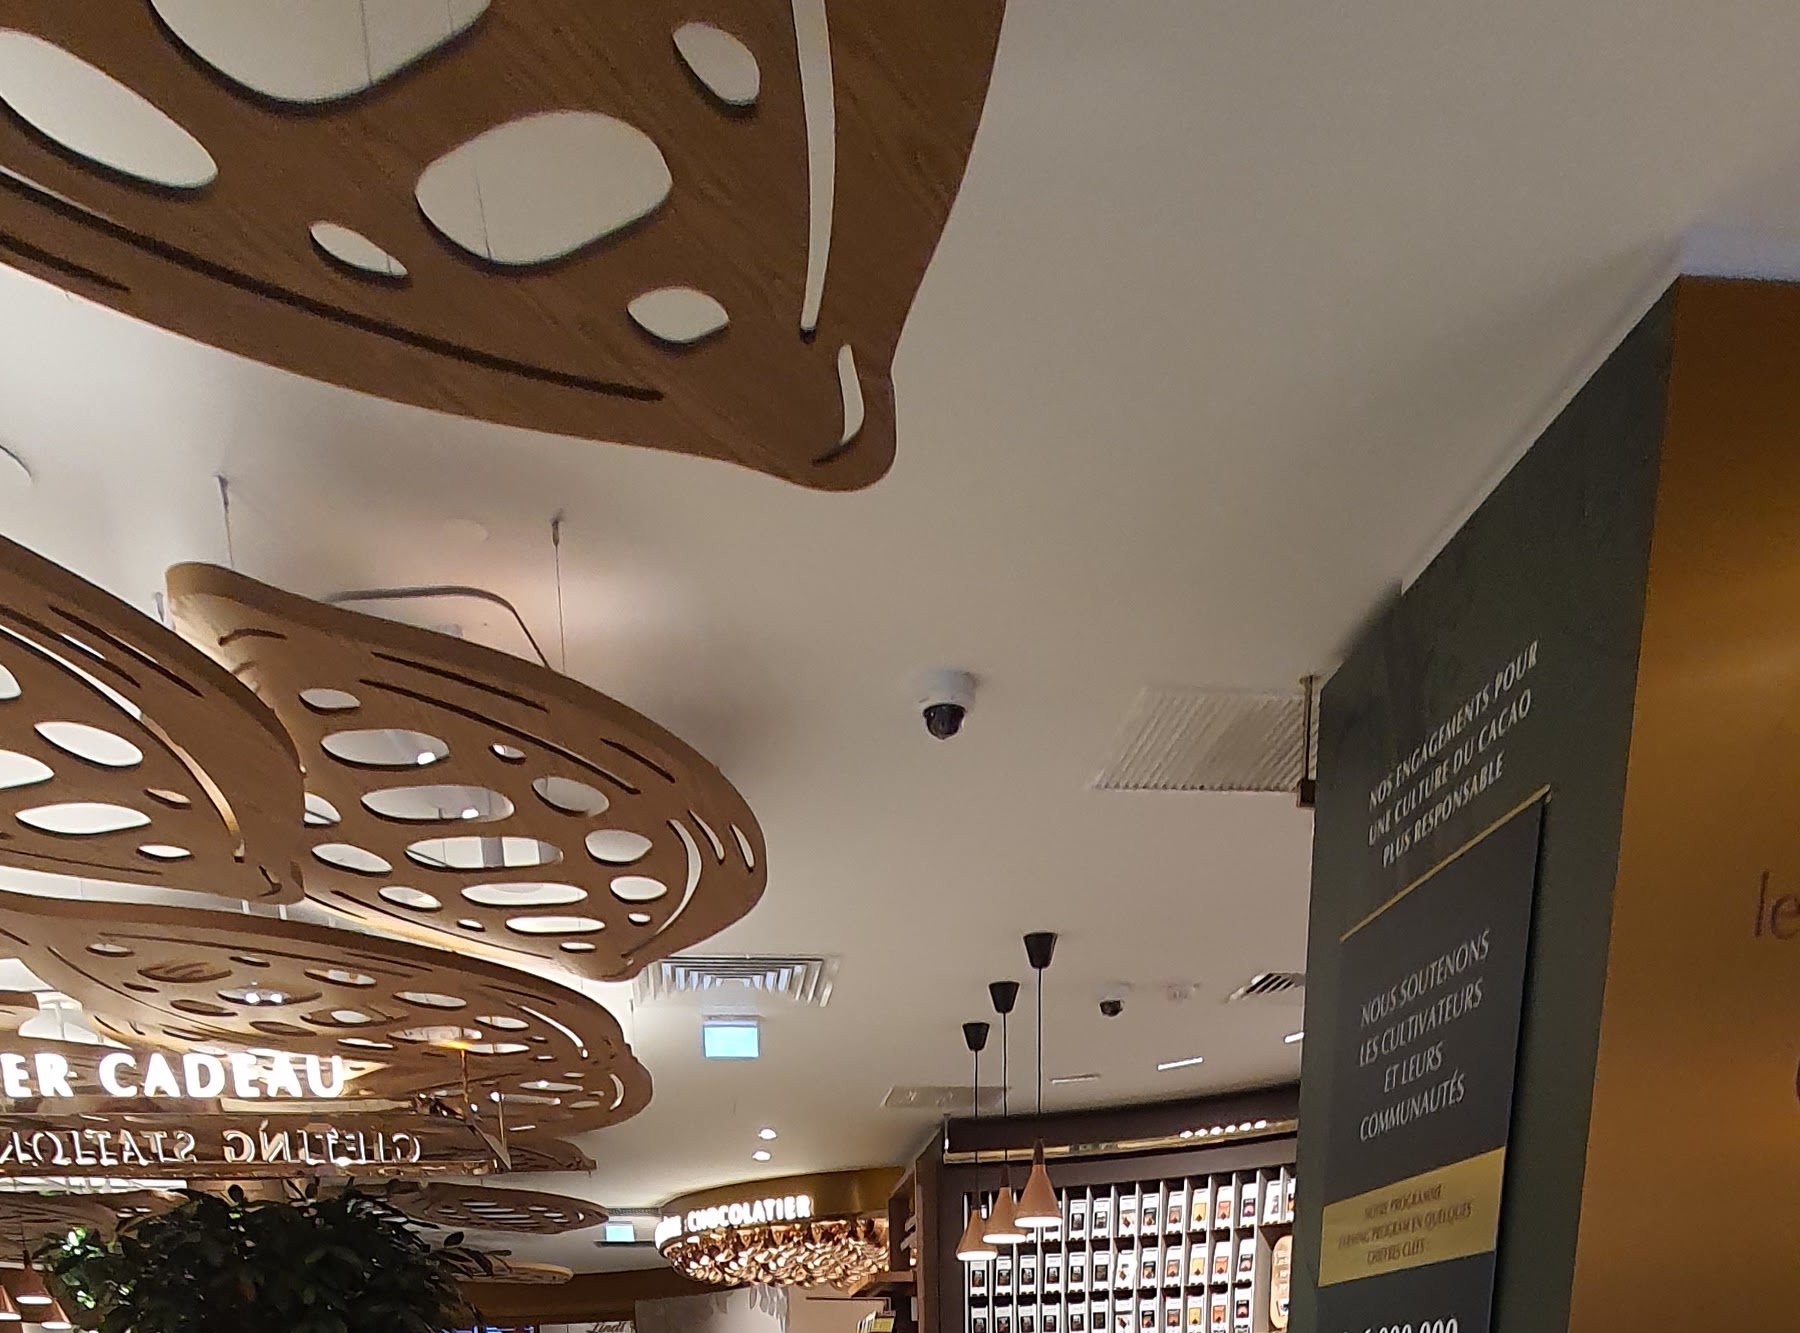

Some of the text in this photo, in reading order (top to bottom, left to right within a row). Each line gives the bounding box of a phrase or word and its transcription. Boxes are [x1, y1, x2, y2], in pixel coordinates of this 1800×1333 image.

[1368, 688, 1532, 847] UNE CULTURE DU CACAO
[1369, 640, 1538, 813] NOS ENGAGEMENTS POUR
[1382, 750, 1505, 868] PLUS RESPONSABLE
[1360, 928, 1490, 1028] NOUS SOUTENONS
[1359, 976, 1484, 1068] LES CULTIVATEURS
[98, 1052, 346, 1098] CADEAU
[1359, 1067, 1466, 1142] COMMUNAUTÉS
[1384, 1040, 1444, 1094] ET LEURS
[687, 1193, 811, 1233] CHOCOLATIER
[1424, 1201, 1473, 1232] QUELQUES
